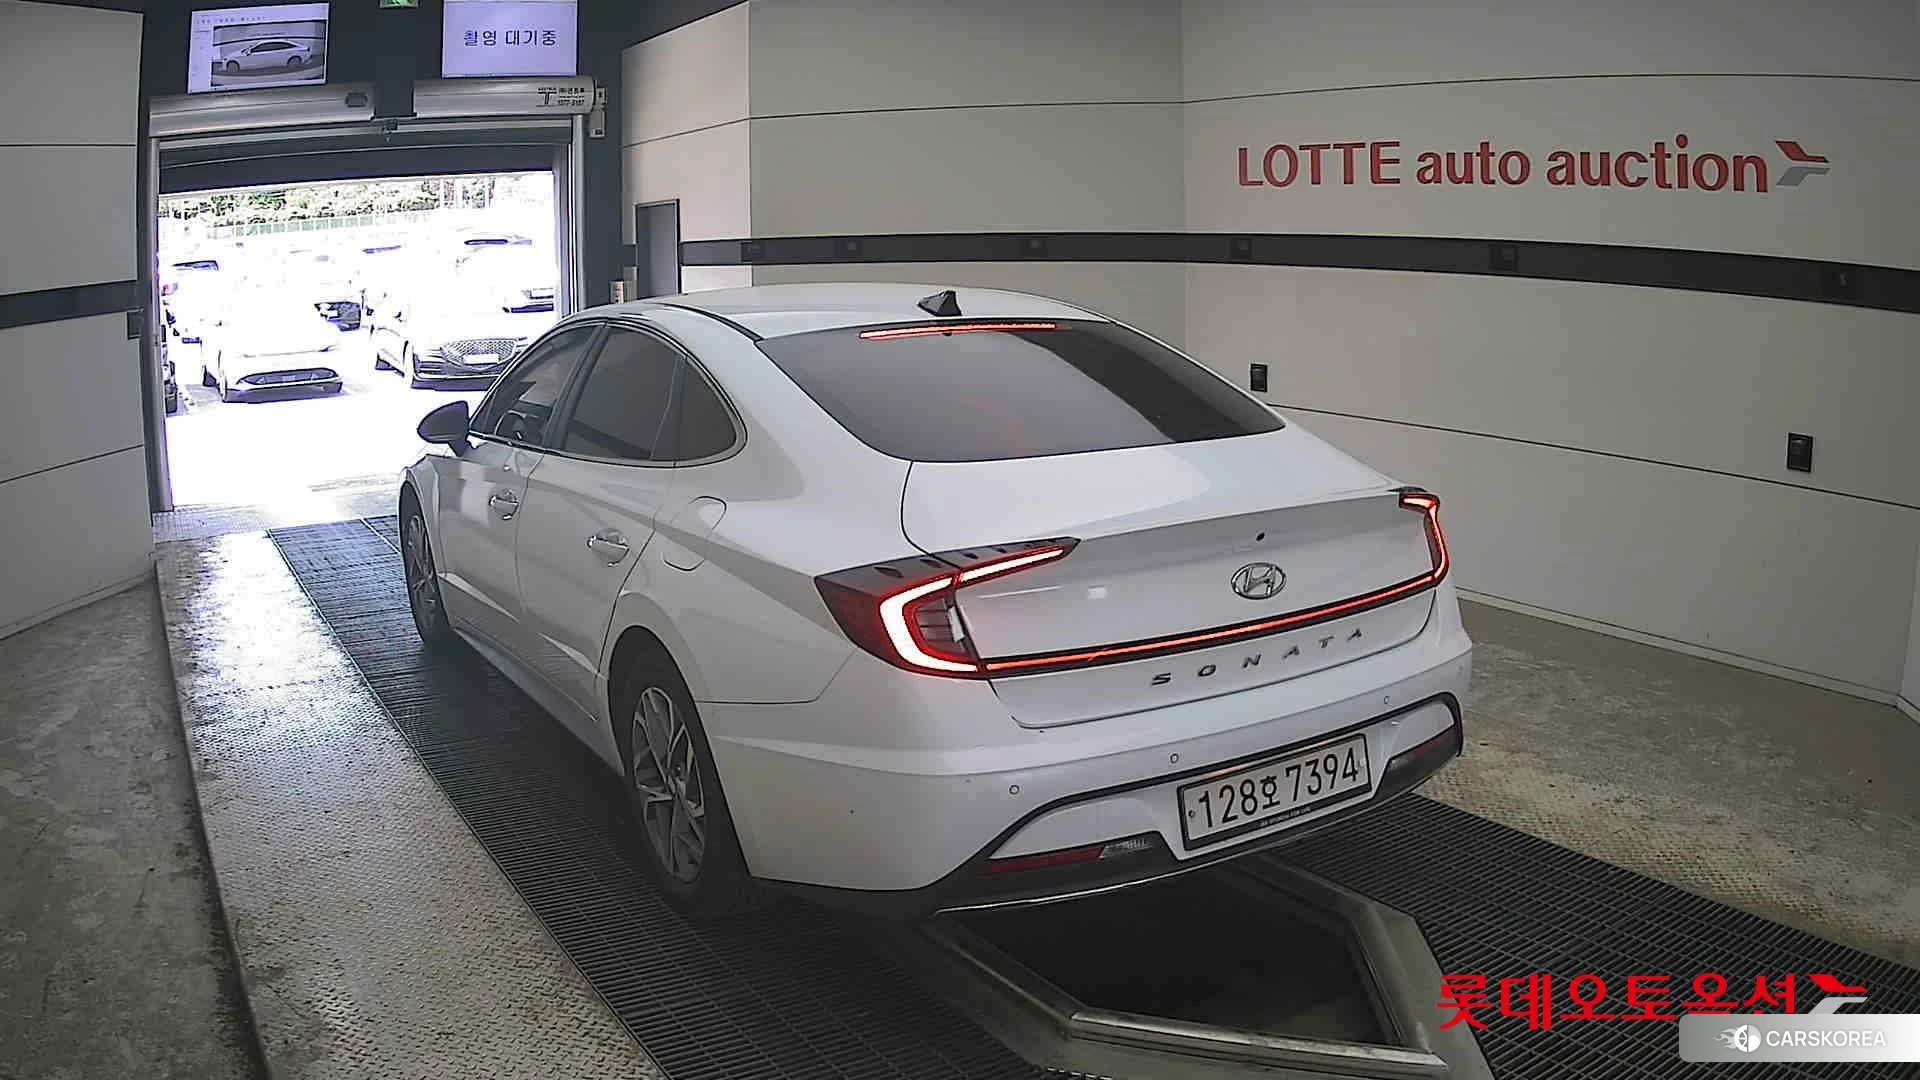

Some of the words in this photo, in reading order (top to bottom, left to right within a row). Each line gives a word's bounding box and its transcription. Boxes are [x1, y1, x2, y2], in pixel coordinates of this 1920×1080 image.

[463, 29, 497, 46] 촬영
[505, 29, 557, 46] 대기중
[1239, 141, 1401, 187] LOTTE
[1416, 141, 1531, 185] auto
[1547, 134, 1768, 192] auction
[1151, 628, 1363, 686] SONATA
